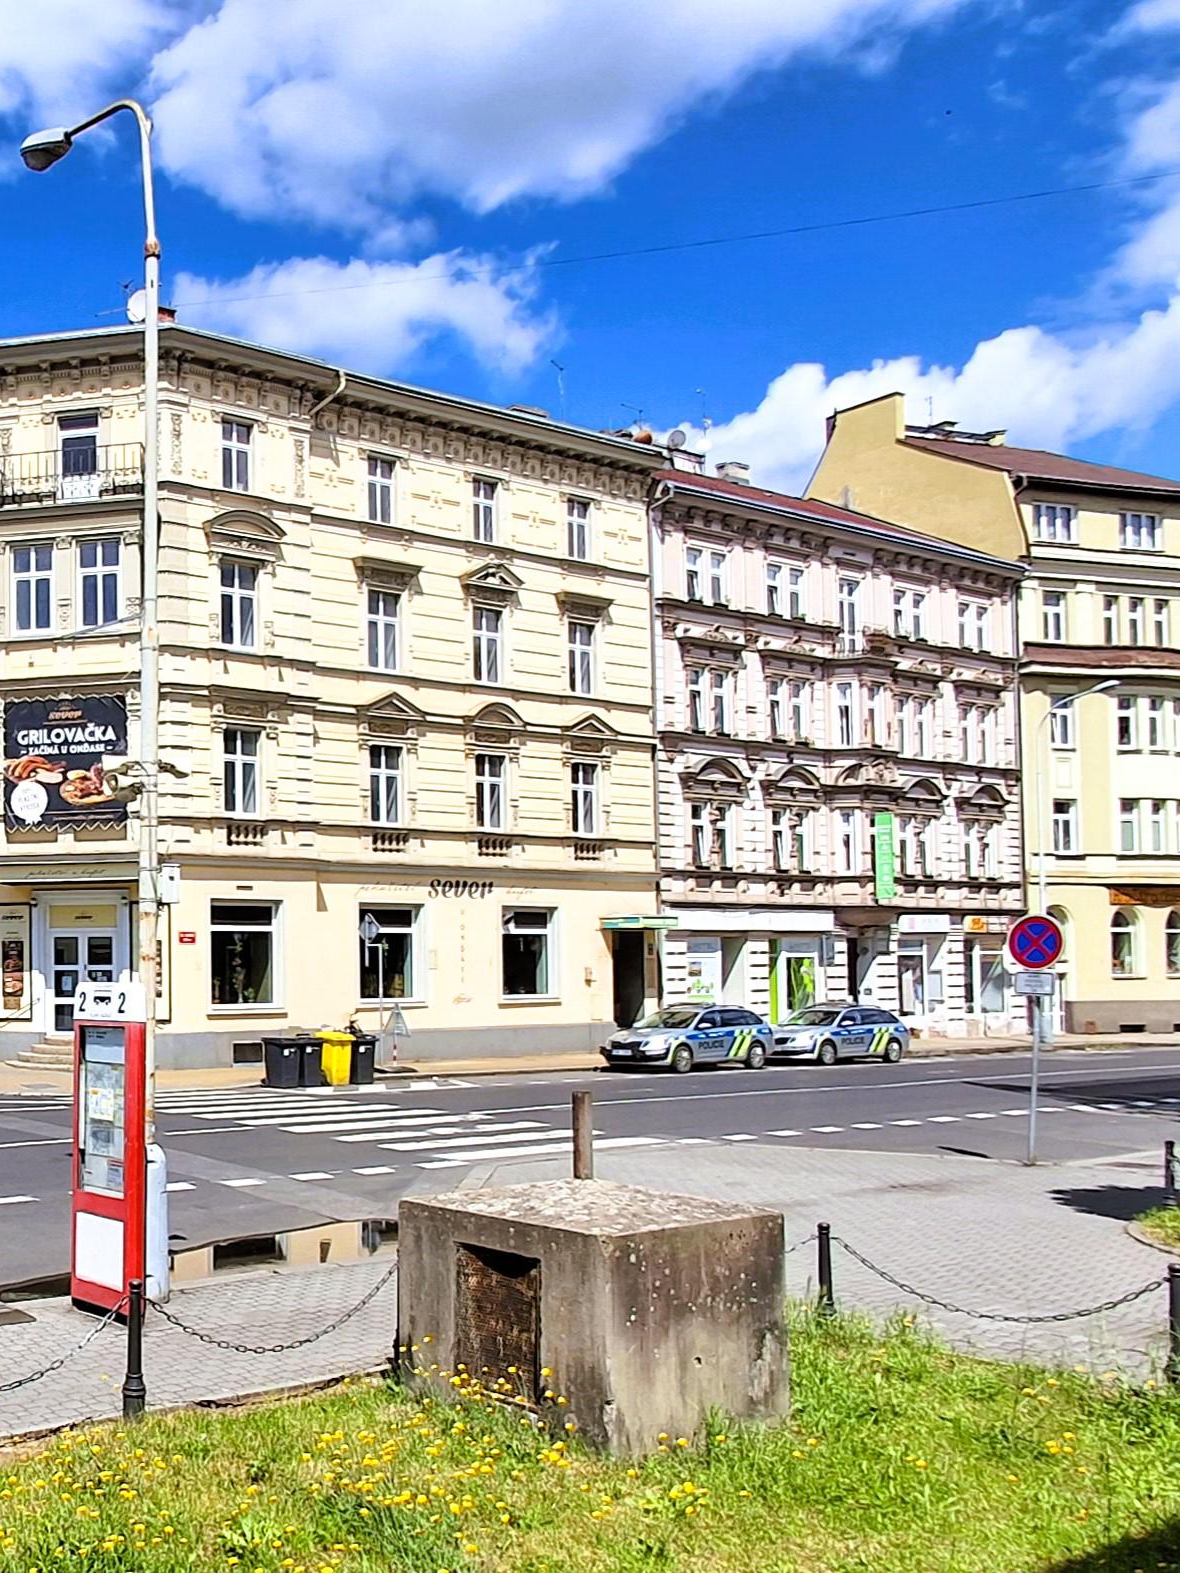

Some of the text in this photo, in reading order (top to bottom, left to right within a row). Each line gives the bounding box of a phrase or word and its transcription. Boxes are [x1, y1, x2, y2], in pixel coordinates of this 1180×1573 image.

[17, 723, 117, 746] GRILOVAČKA
[61, 745, 68, 754] U
[427, 878, 494, 900] sever
[78, 991, 126, 1014] 2 2
[698, 1039, 725, 1050] POLICIE
